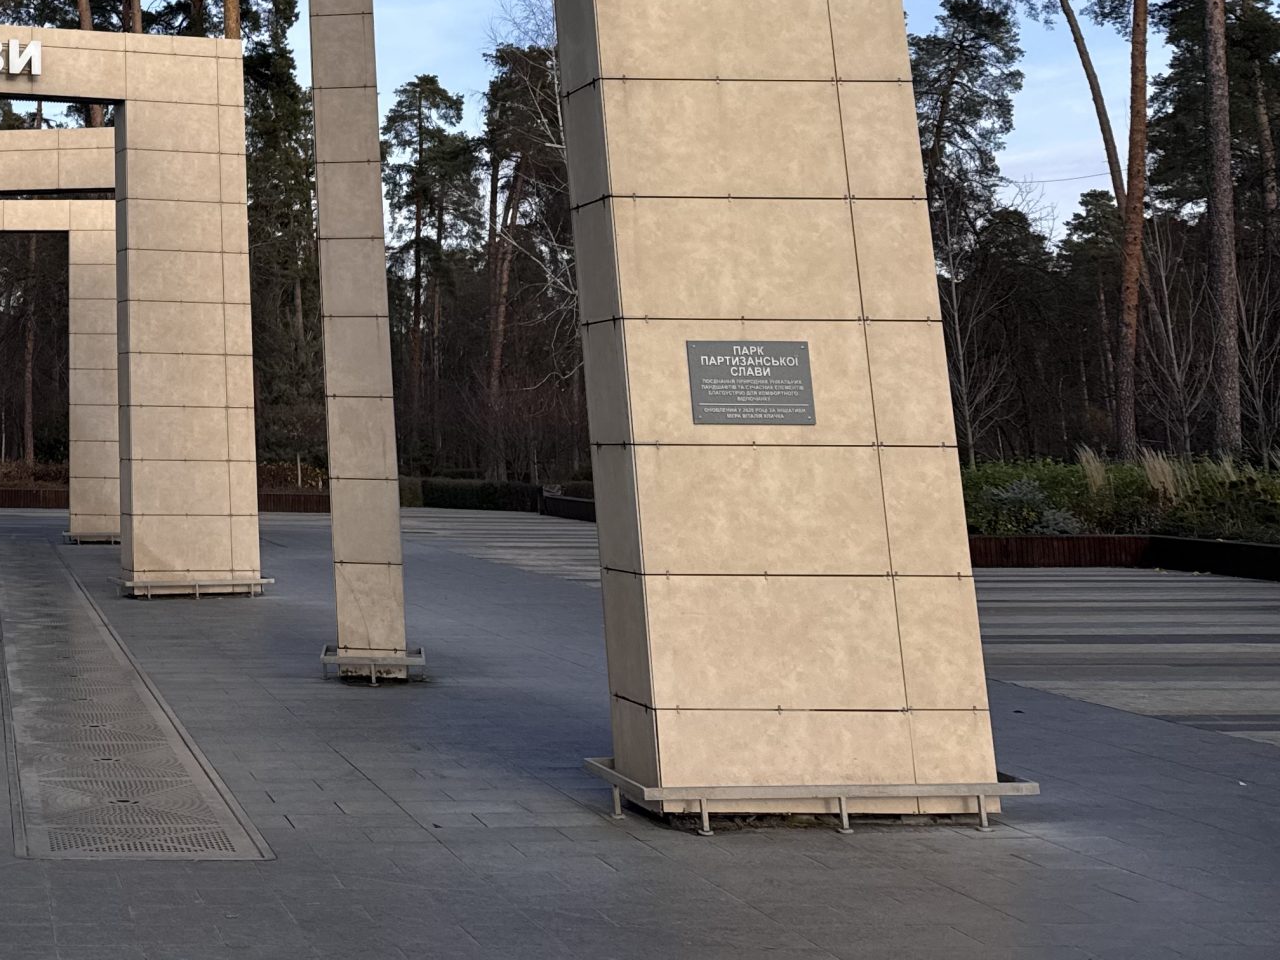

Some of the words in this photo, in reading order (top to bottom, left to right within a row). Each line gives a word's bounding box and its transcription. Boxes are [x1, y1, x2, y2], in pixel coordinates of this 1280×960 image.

[733, 345, 764, 356] ПАРК
[700, 353, 799, 366] ПАРТИЗАНСЬКОЇ
[730, 366, 771, 377] СЛАВИ
